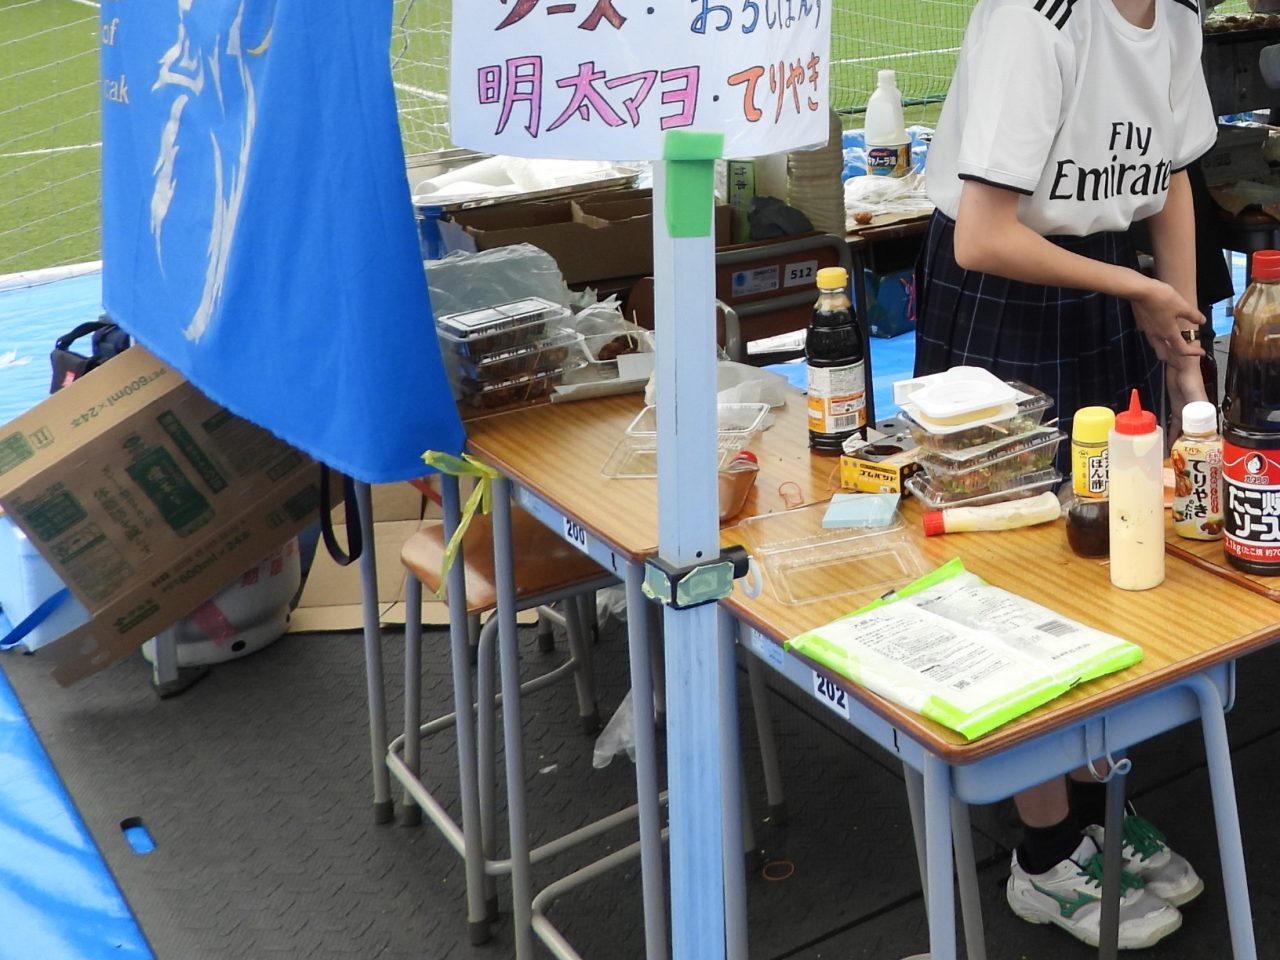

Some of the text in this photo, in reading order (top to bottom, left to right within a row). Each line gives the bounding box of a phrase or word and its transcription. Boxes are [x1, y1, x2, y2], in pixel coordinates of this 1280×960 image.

[1108, 121, 1152, 157] Fly
[790, 267, 812, 280] 512
[1188, 459, 1208, 519] てりやき
[816, 674, 846, 710] 202
